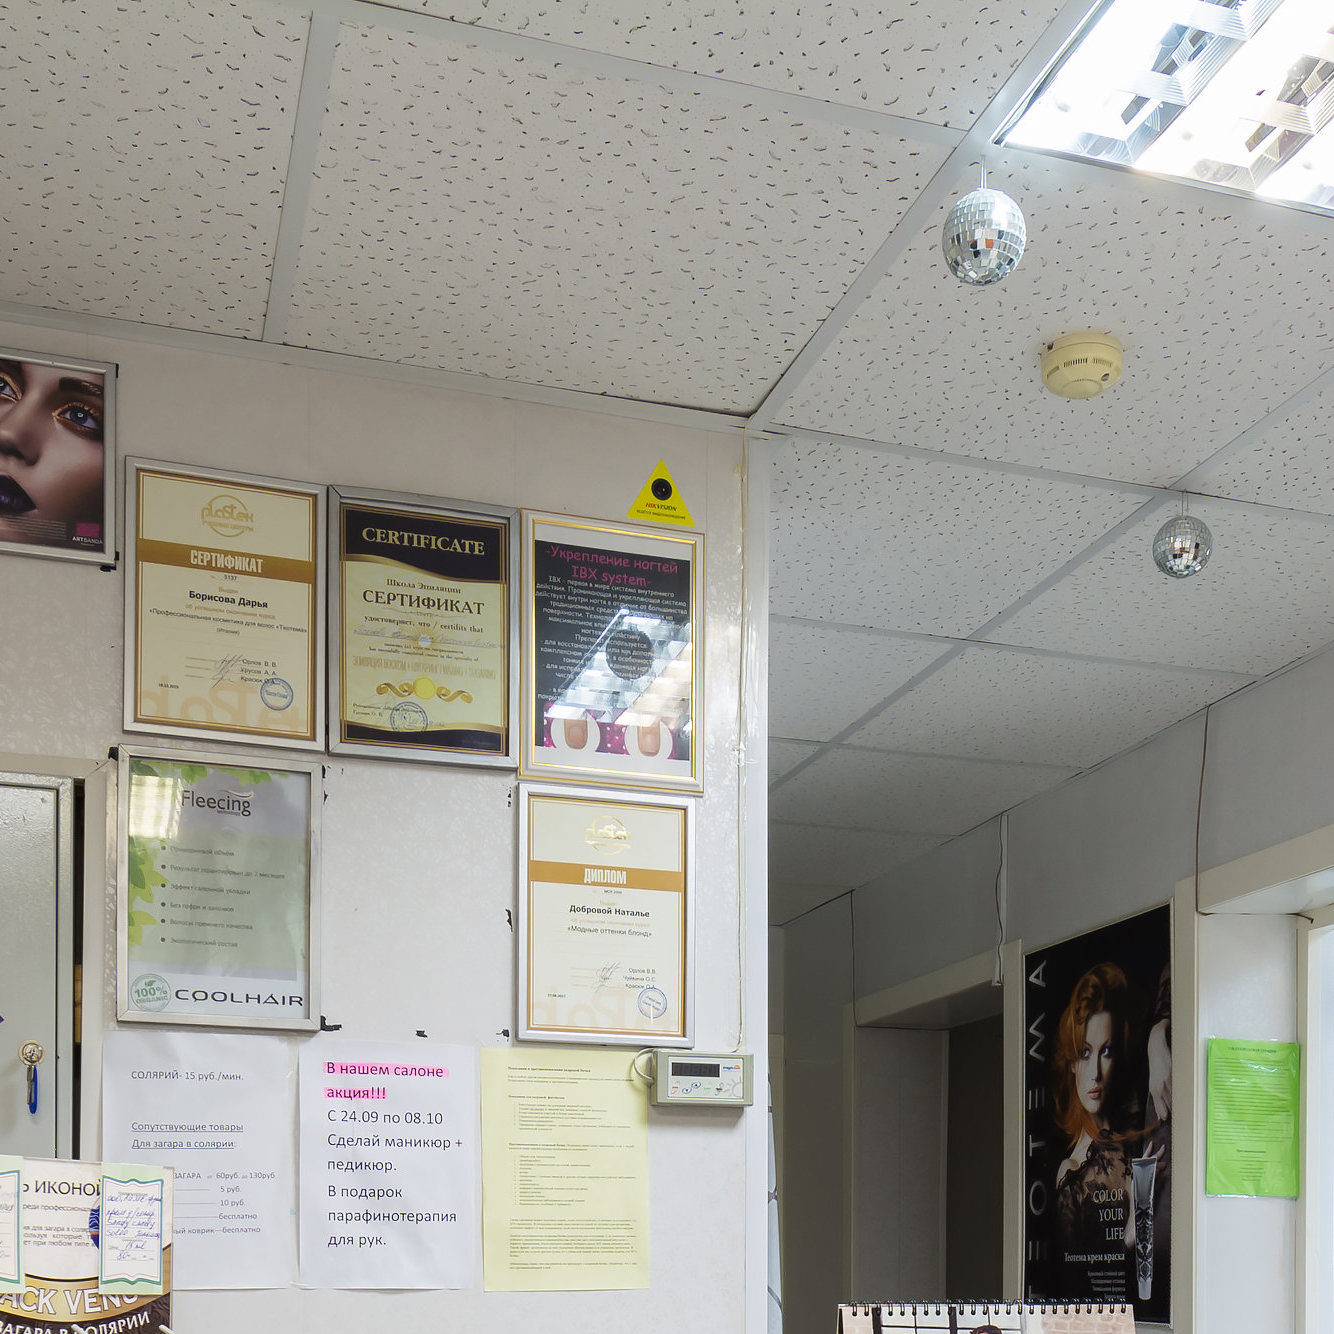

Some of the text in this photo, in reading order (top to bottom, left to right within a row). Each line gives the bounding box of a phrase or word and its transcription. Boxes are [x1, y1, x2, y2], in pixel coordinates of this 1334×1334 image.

[645, 502, 678, 512] HIKVISION
[362, 527, 485, 556] CERTIFICATE
[190, 549, 263, 574] СЕРТИФИКАТ
[633, 559, 679, 574] ногтей
[571, 565, 597, 580] IBX
[386, 578, 461, 594] Школа Эпиляции
[189, 590, 268, 609] Борисова Дарья
[362, 590, 485, 615] СЕРТИФИКАТ
[244, 618, 256, 627] для
[181, 790, 252, 817] Fleecing
[584, 868, 627, 884] ДИПЛОМ
[569, 905, 650, 918] Добровой Наталье
[568, 925, 652, 938] «Модные оттенки блонд»
[175, 989, 303, 1007] COOLHAIR
[185, 1072, 196, 1080] 15
[198, 1071, 244, 1082] руб./мин.
[327, 1062, 444, 1077] В нашем салоне
[327, 1087, 387, 1100] акция!!!
[327, 1110, 443, 1125] С 24.09 по 08.10
[131, 1122, 244, 1132] Сопутствующие товары
[132, 1139, 151, 1149] Для
[153, 1141, 184, 1149] загара
[194, 1141, 237, 1149] солярии:
[327, 1134, 451, 1150] Сделай маникюр
[327, 1160, 397, 1173] педикюр.
[328, 1185, 403, 1200] В подарок
[1093, 1190, 1125, 1204] COLOR
[218, 1212, 257, 1221] бесплатно
[328, 1209, 457, 1224] парафинотерапия
[1098, 1208, 1125, 1222] YOUR
[1105, 1226, 1125, 1241] LIFE
[328, 1235, 387, 1248] для рук.
[1064, 1252, 1125, 1264] Теотема крем краска
